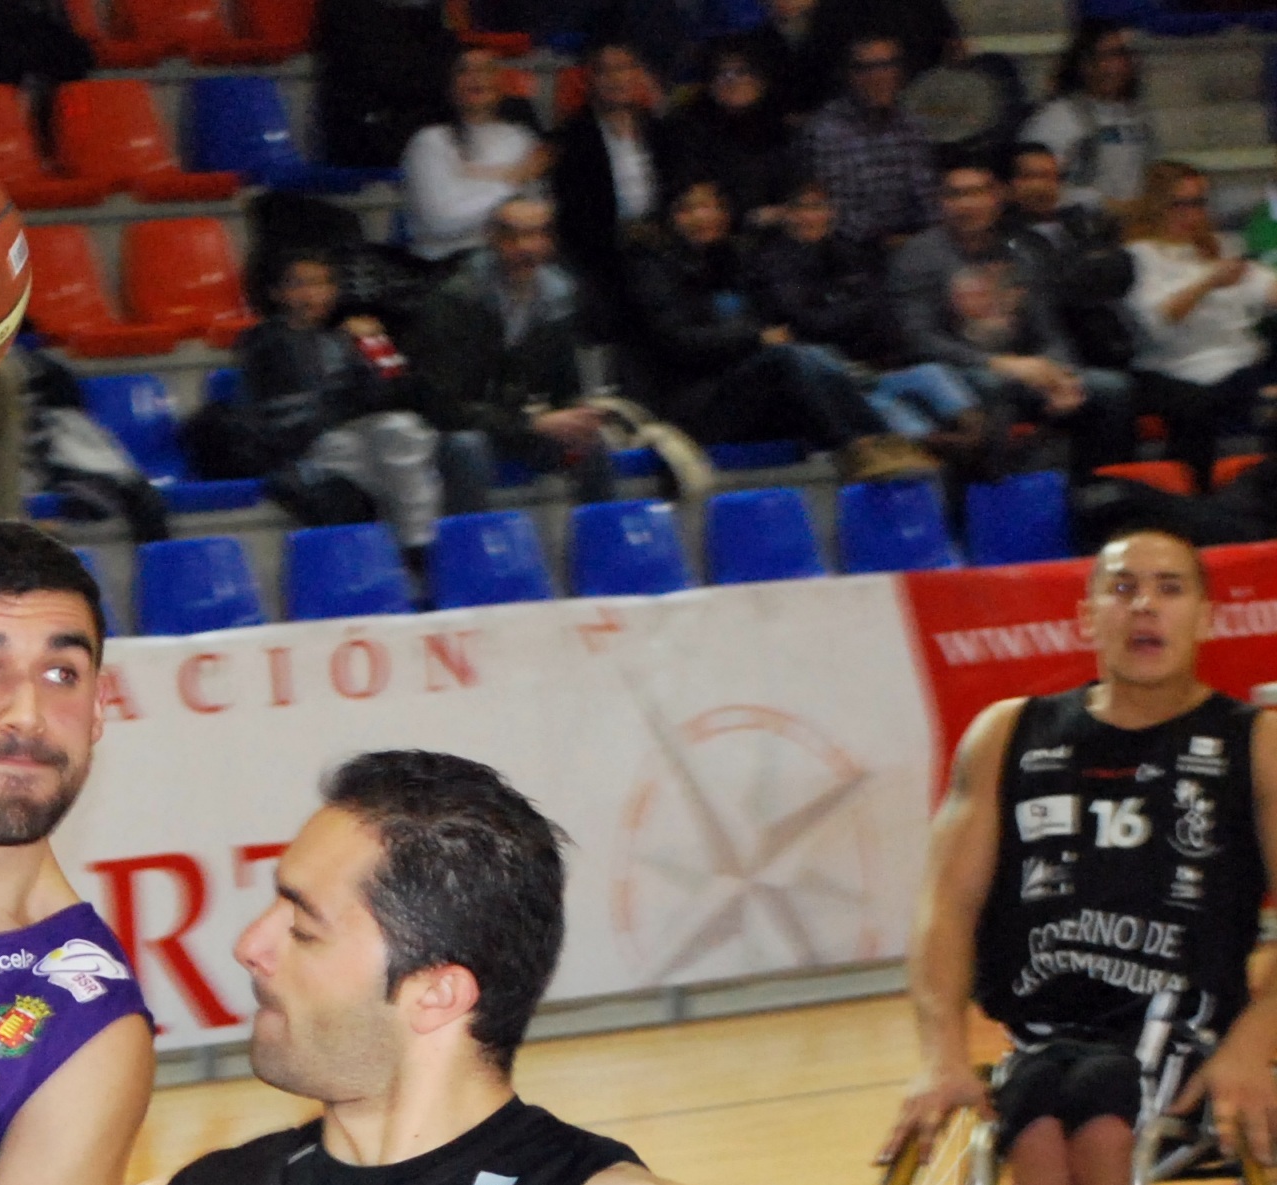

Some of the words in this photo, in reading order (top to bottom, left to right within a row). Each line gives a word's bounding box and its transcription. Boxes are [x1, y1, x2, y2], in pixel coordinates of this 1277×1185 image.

[1088, 797, 1153, 849] 16
[1142, 919, 1186, 960] DE
[71, 971, 99, 995] BSR
